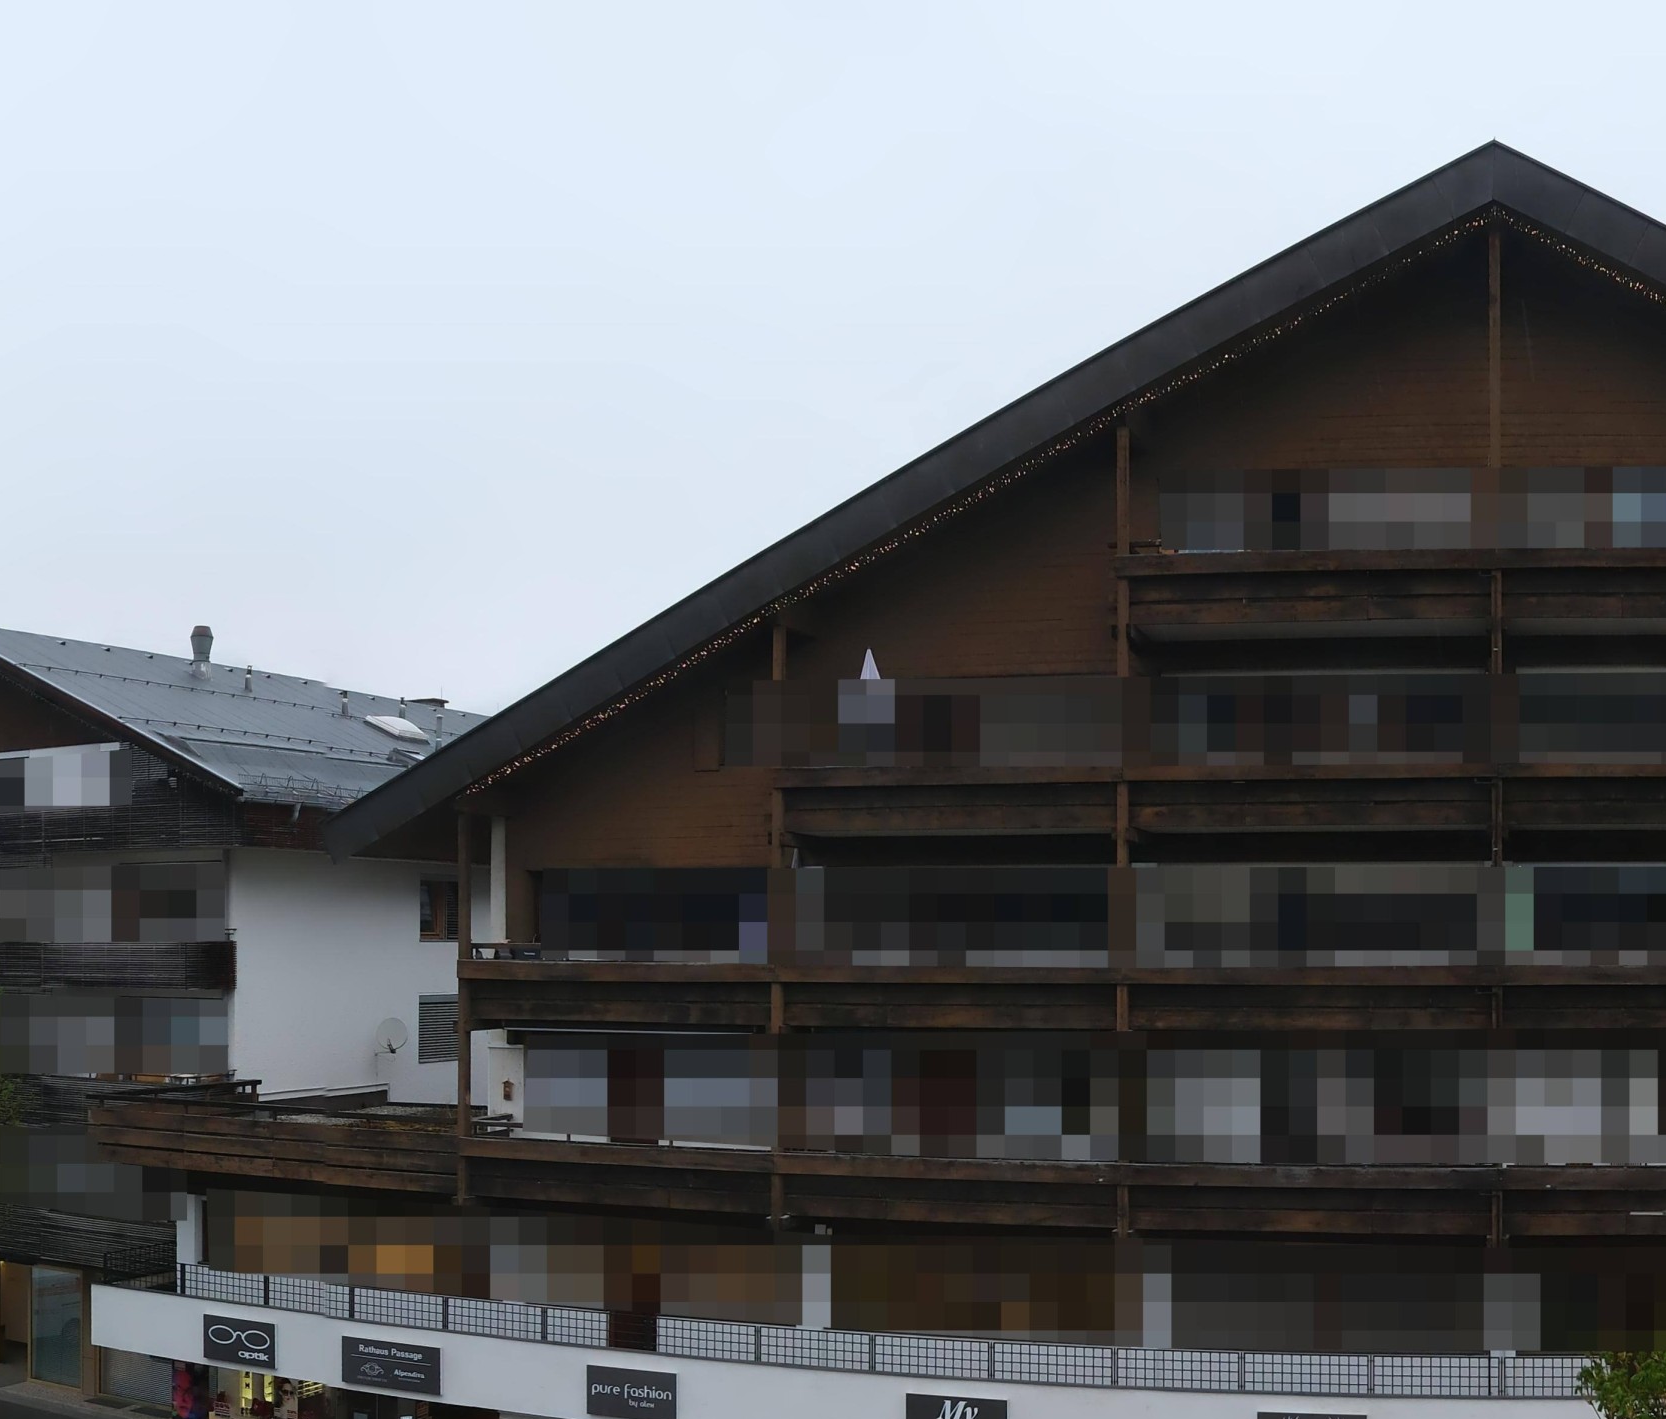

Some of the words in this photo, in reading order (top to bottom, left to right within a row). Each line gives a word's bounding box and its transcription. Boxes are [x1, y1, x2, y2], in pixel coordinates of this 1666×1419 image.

[238, 1350, 269, 1362] optik
[358, 1344, 389, 1355] Rathaus
[391, 1348, 422, 1361] Passage
[591, 1383, 620, 1396] pure
[624, 1384, 672, 1400] fashion
[629, 1399, 638, 1408] by
[640, 1400, 655, 1408] alex
